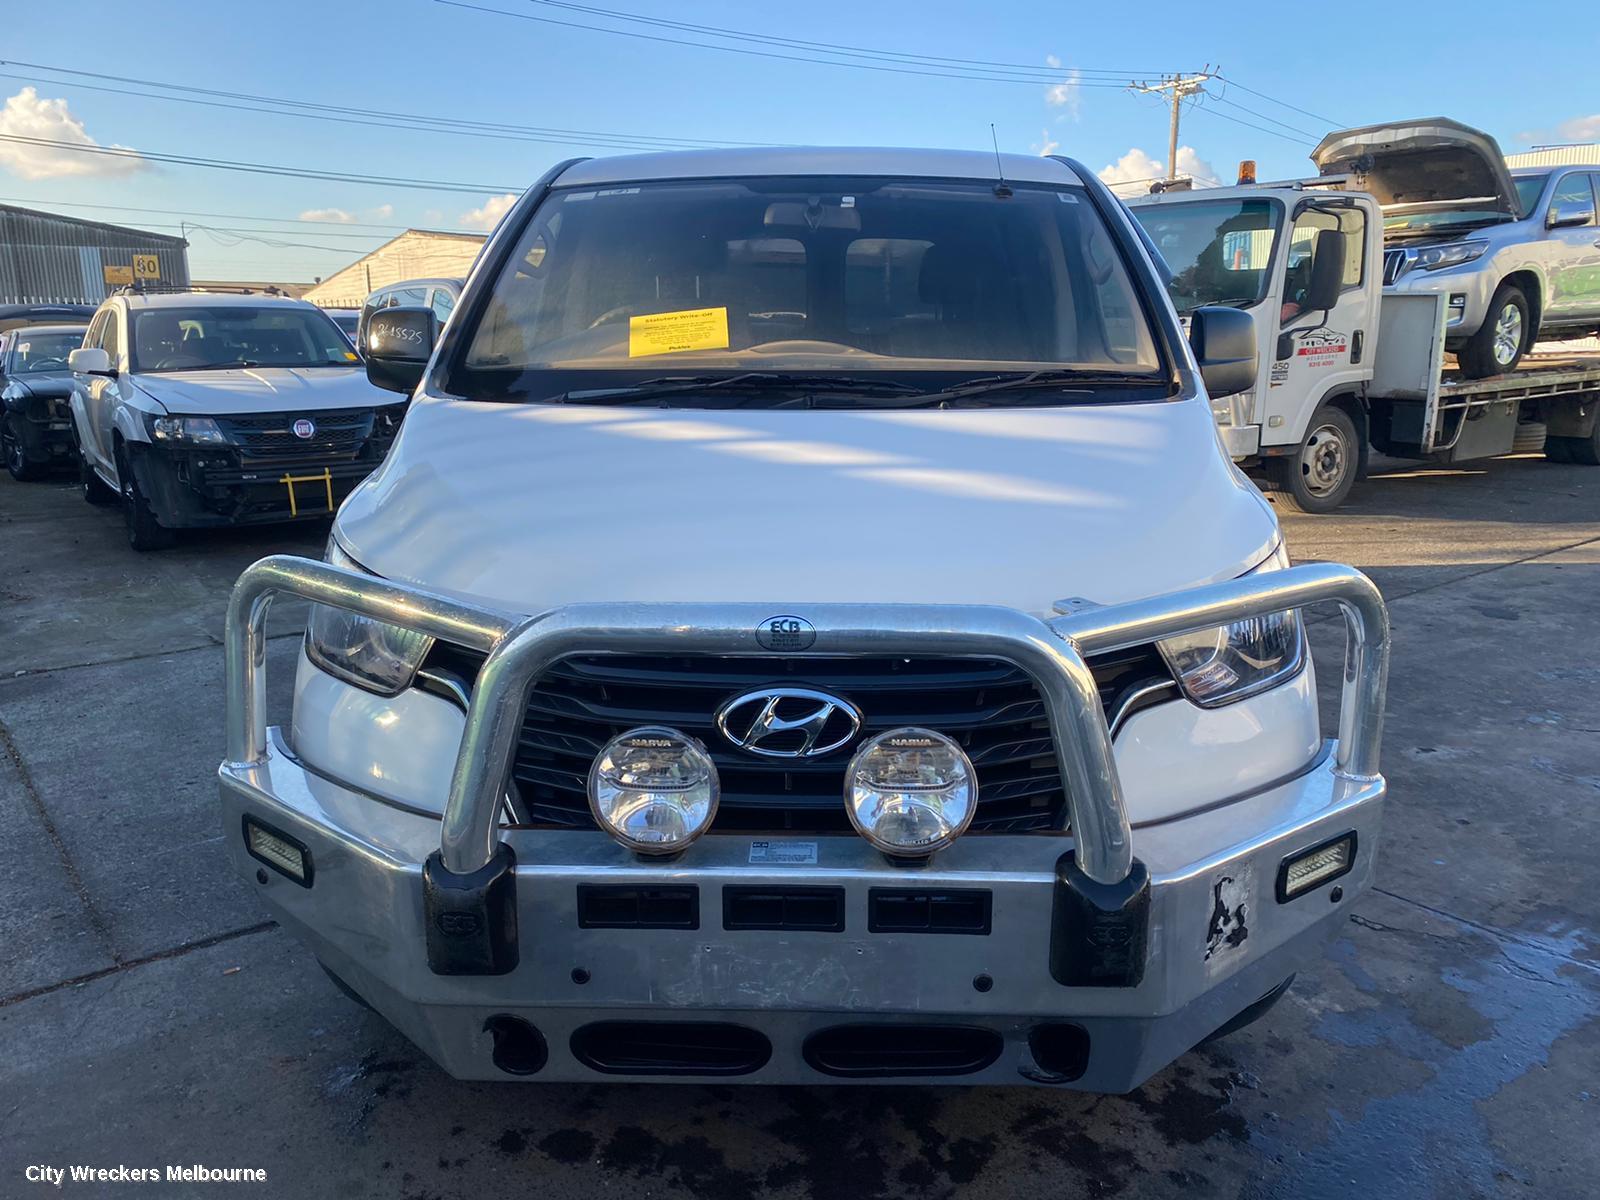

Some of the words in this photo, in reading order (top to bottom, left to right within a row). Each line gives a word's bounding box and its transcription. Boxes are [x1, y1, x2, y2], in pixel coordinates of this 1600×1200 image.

[1272, 362, 1289, 370] 450
[770, 619, 801, 633] ECB
[632, 739, 672, 747] NARVA
[891, 739, 932, 747] NARVA
